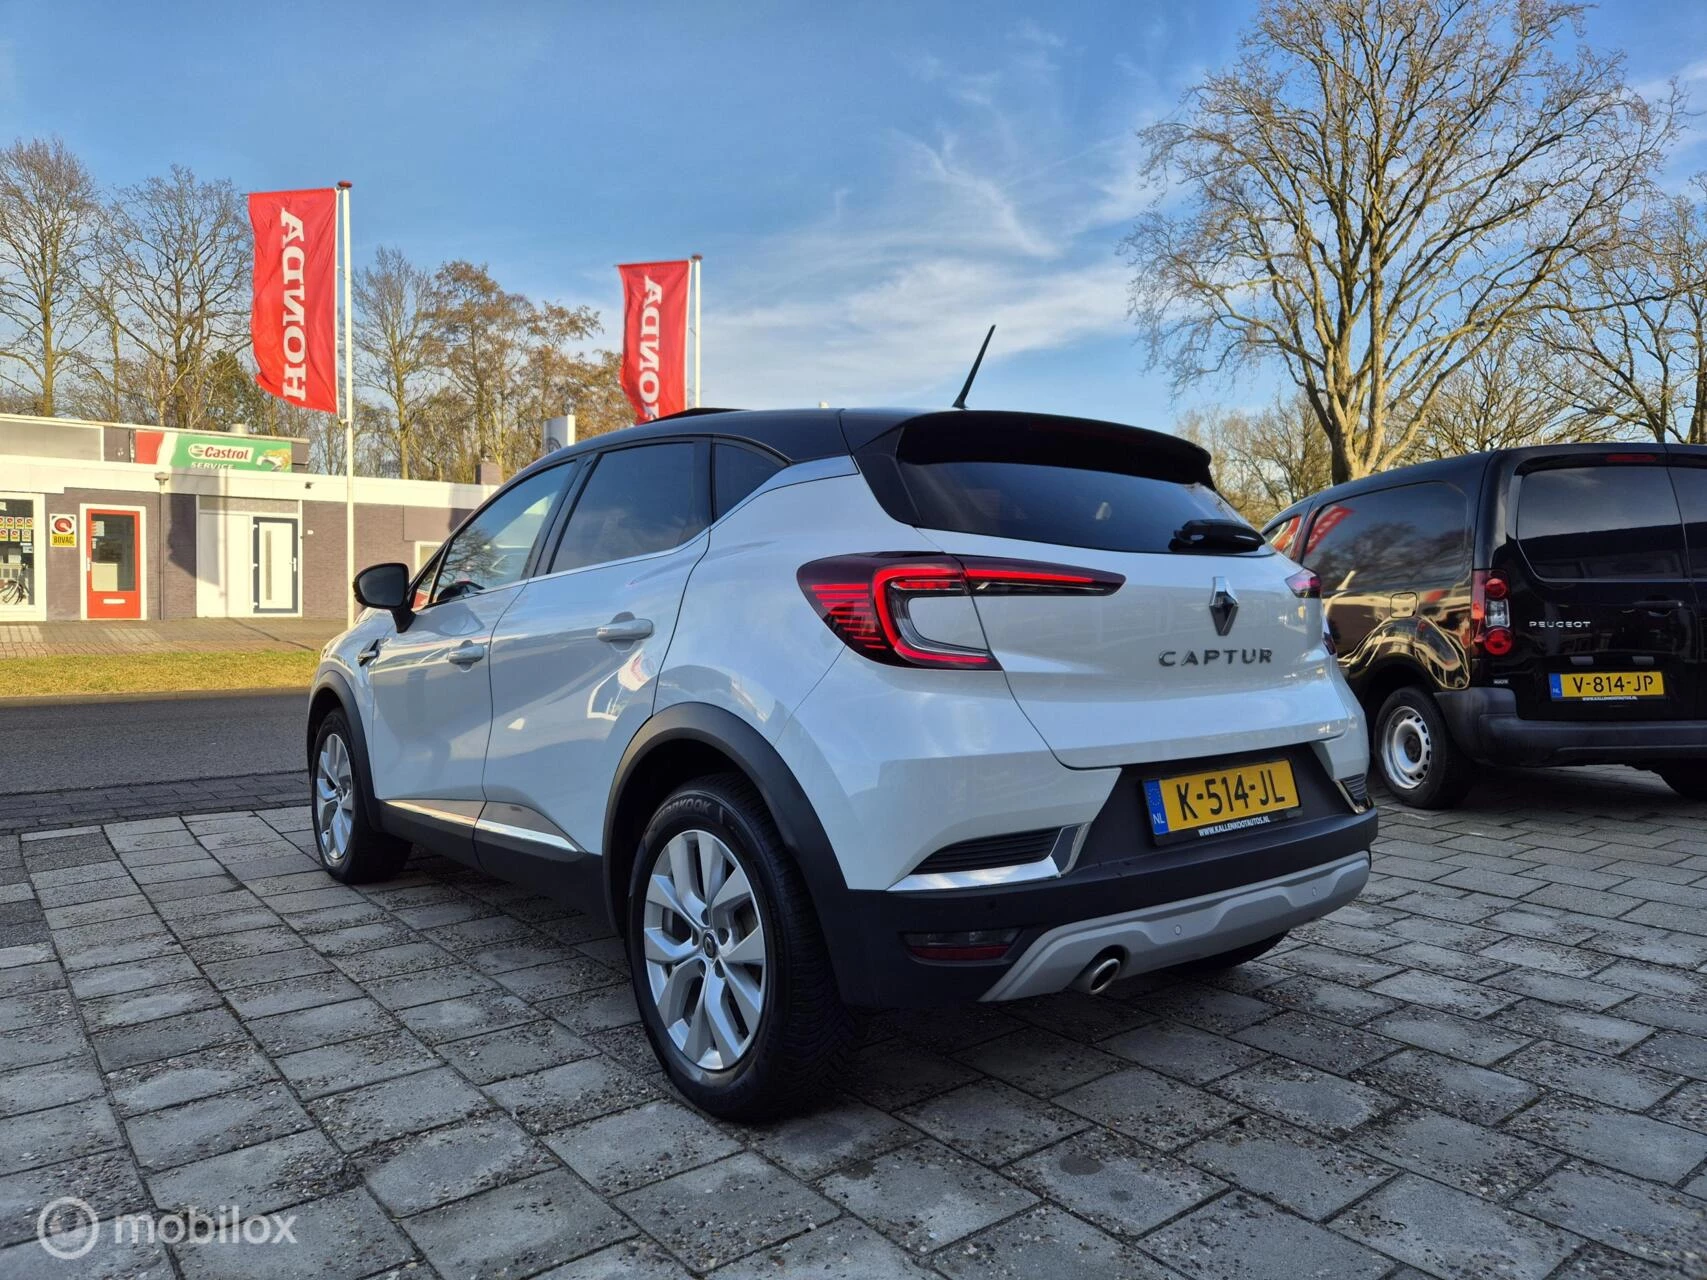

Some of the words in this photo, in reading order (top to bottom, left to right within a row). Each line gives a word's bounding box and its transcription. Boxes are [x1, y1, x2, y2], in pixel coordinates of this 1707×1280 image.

[204, 446, 249, 460] Castrol
[1158, 648, 1273, 667] CAPTUR
[1572, 675, 1654, 693] V-814-JP
[1176, 769, 1286, 822] K-514-JL
[1153, 812, 1166, 825] NL
